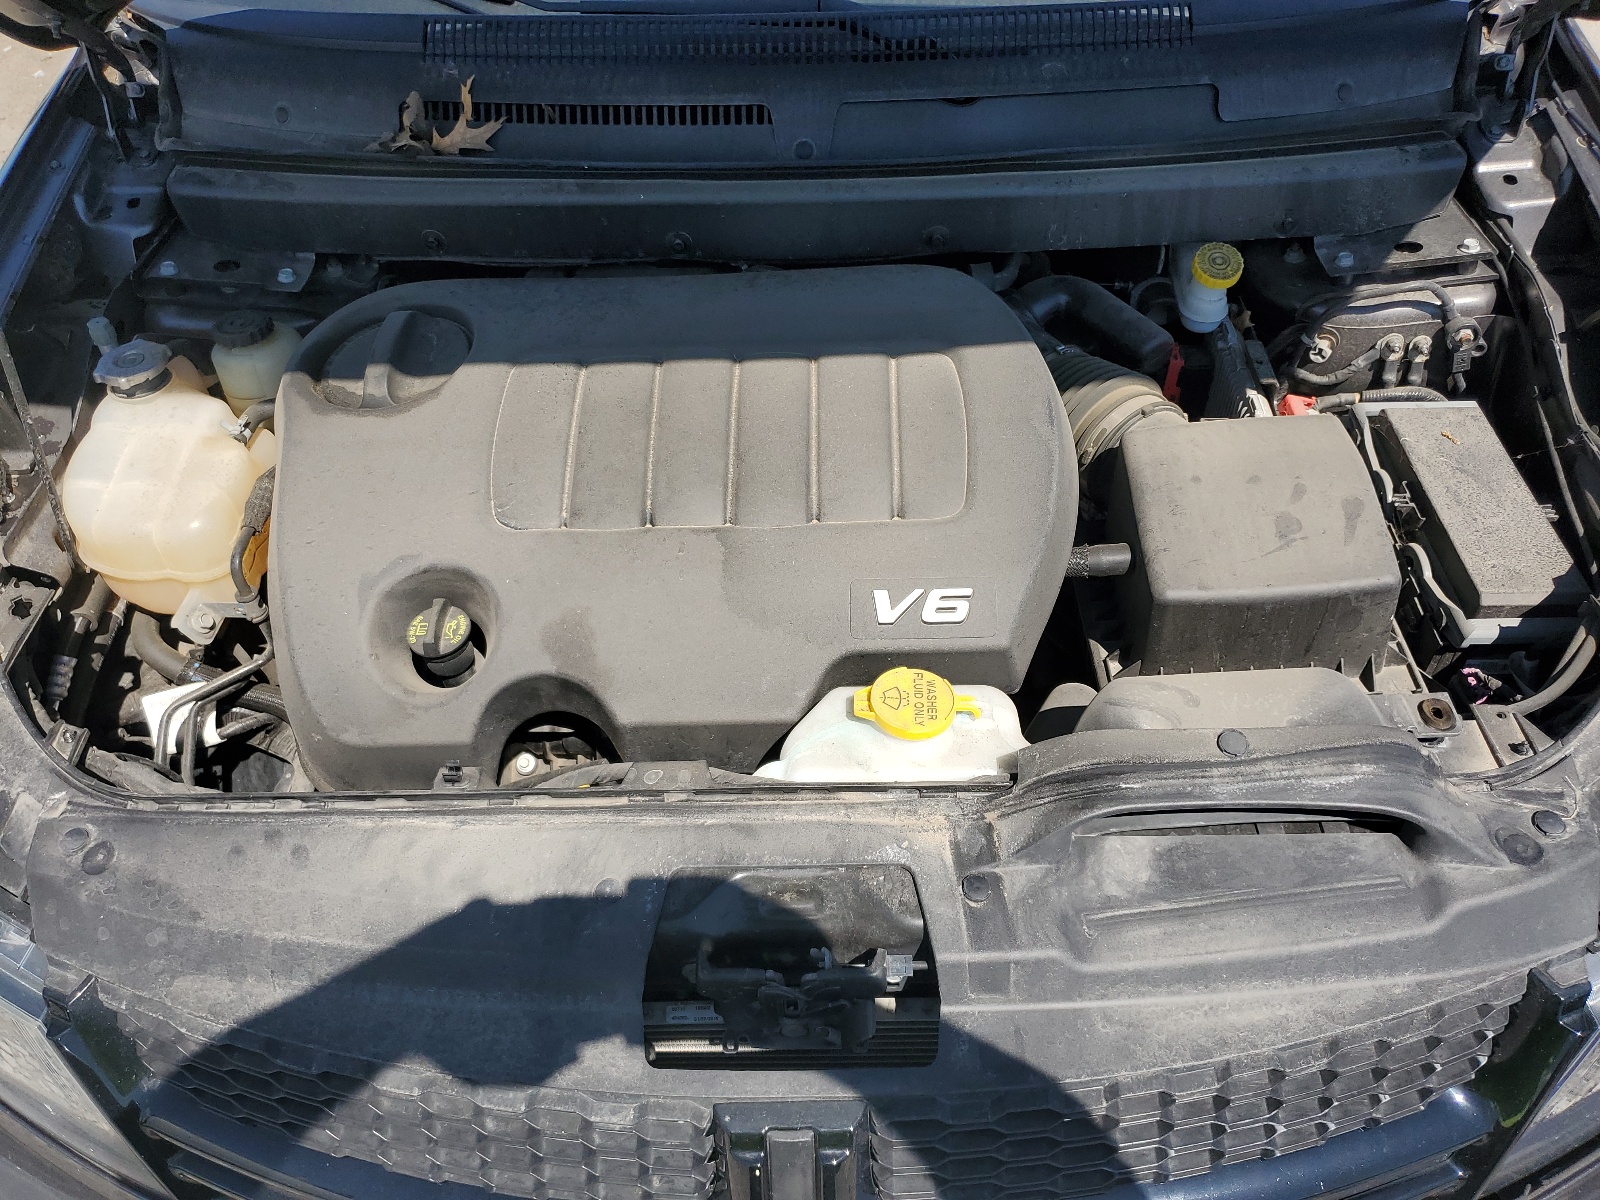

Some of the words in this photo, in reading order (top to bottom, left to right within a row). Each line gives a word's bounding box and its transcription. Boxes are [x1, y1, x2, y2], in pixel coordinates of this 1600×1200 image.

[872, 588, 974, 626] V6
[458, 614, 466, 635] ENGINE
[450, 636, 462, 644] OIL
[913, 672, 924, 699] FLUID
[926, 679, 938, 721] WASHER
[914, 701, 925, 727] ONLY
